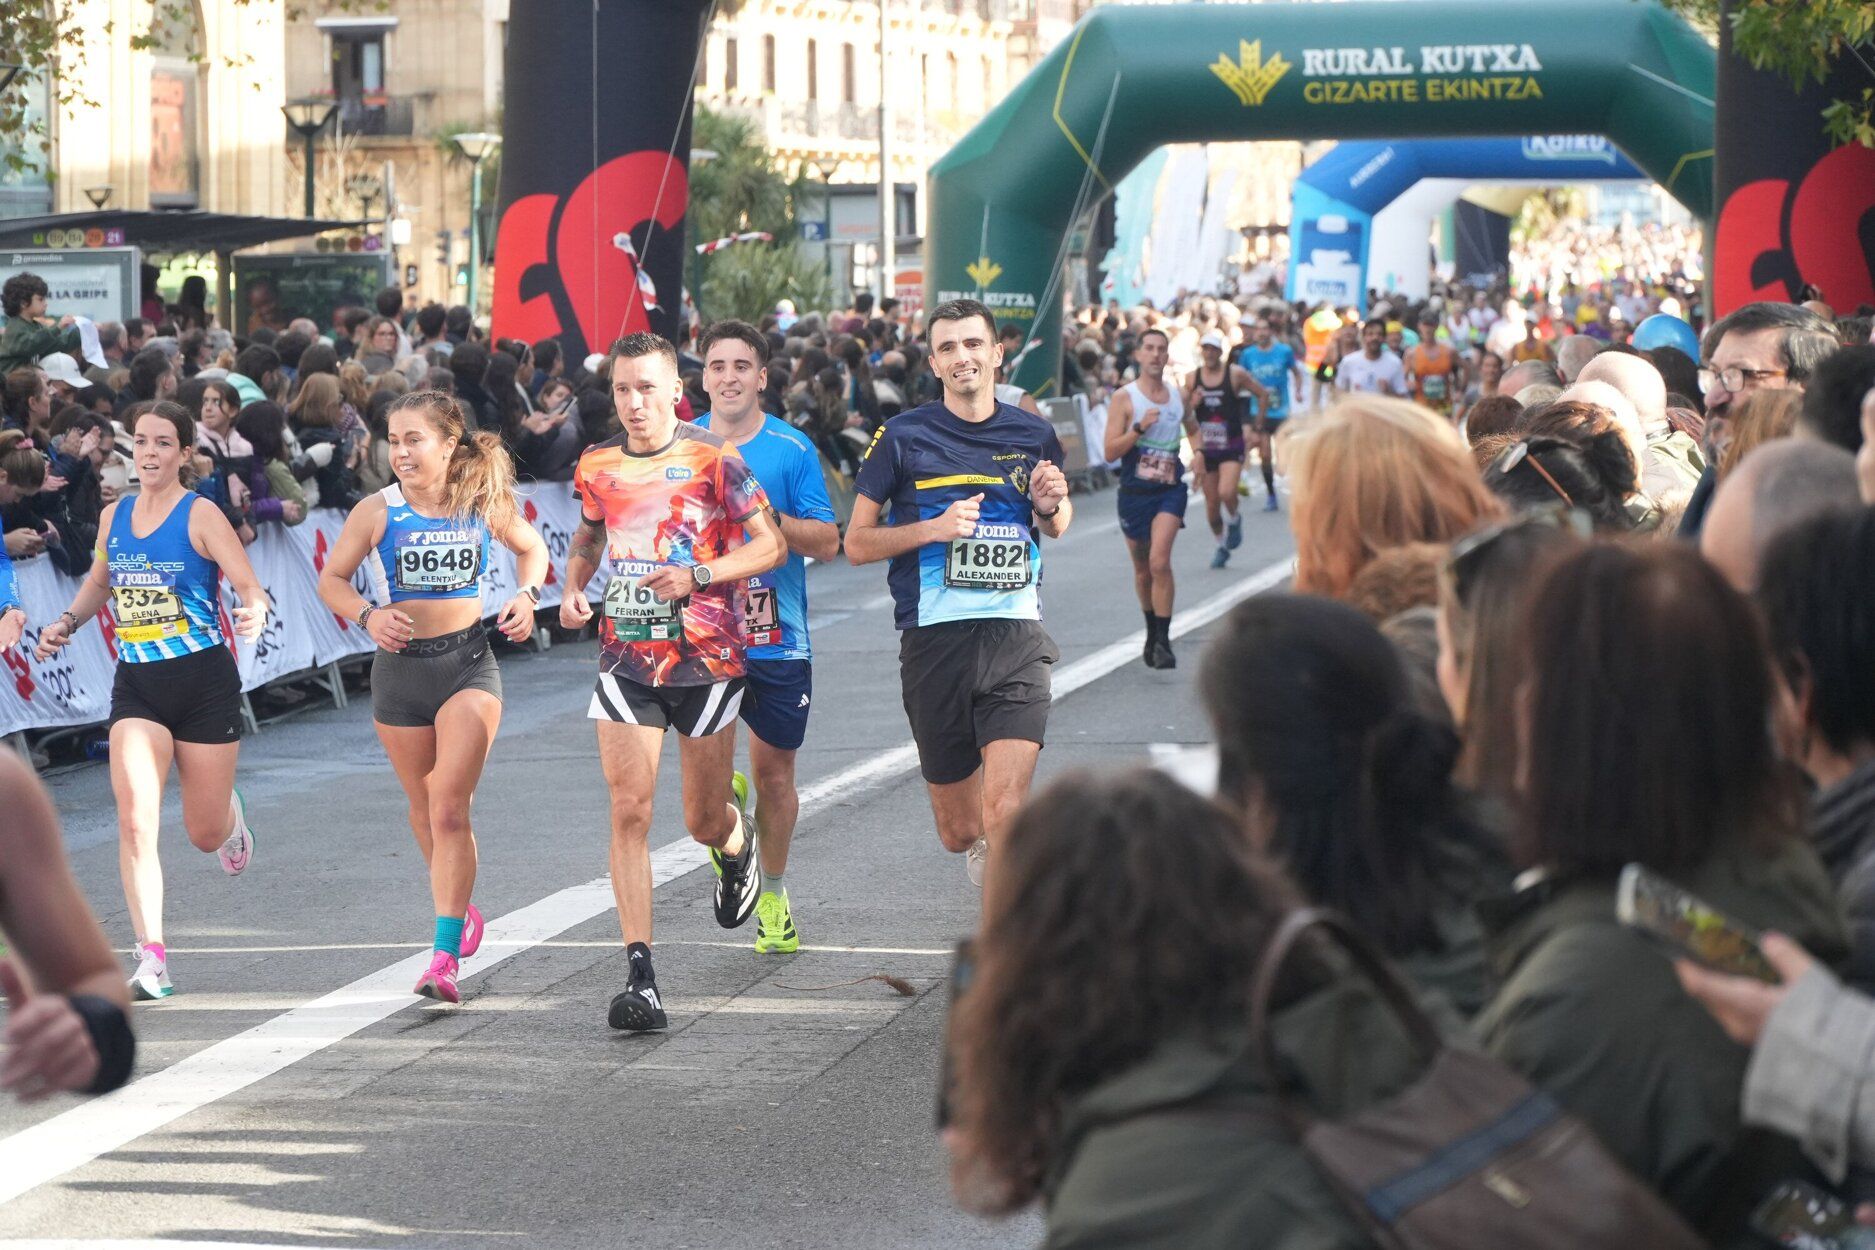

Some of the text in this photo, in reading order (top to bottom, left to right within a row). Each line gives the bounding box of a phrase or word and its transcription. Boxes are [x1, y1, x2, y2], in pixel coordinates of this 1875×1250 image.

[1303, 43, 1543, 76] RURAL KUTXA
[1303, 76, 1543, 104] GIZARTE EKINTZA
[107, 231, 120, 244] 21
[56, 290, 71, 299] LA
[73, 289, 109, 299] GRIPE
[116, 553, 147, 562] CLUB
[403, 548, 474, 573] 9648
[954, 542, 1024, 568] 1882
[421, 574, 457, 583] ELENTXU
[956, 570, 1022, 581] ALEXANDER
[121, 588, 169, 609] 332
[131, 609, 160, 620] ELENA
[615, 606, 655, 616] FERRAN
[406, 640, 449, 653] PRO
